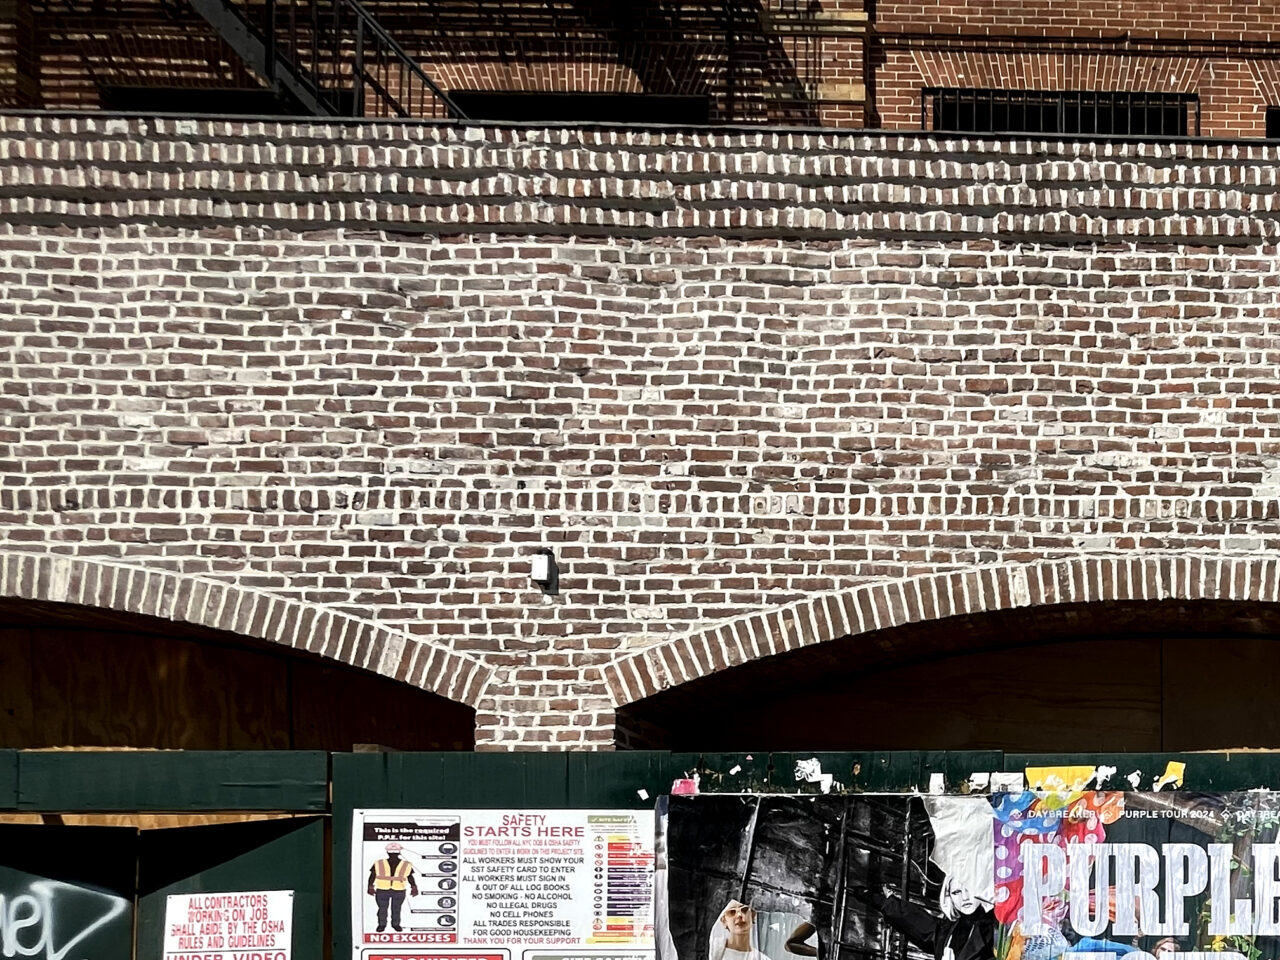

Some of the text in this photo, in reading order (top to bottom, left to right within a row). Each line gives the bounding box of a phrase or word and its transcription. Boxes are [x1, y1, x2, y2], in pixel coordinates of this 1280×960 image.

[503, 815, 546, 826] SAFETY
[1119, 810, 1158, 819] PURPLE
[1160, 810, 1188, 819] TOUR
[1190, 810, 1214, 819] 2024
[464, 826, 531, 837] STARTS
[538, 827, 585, 837] HERE
[189, 895, 268, 909] ALL CONTRACTORS
[188, 908, 268, 923] WORKING ON JOB
[200, 923, 222, 935] ABIDE
[228, 922, 238, 934] BY
[243, 921, 257, 933] THE
[261, 920, 285, 933] OSHA
[179, 934, 275, 949] RULES AND GUIDELINES
[370, 934, 451, 942] NO EXCUSES
